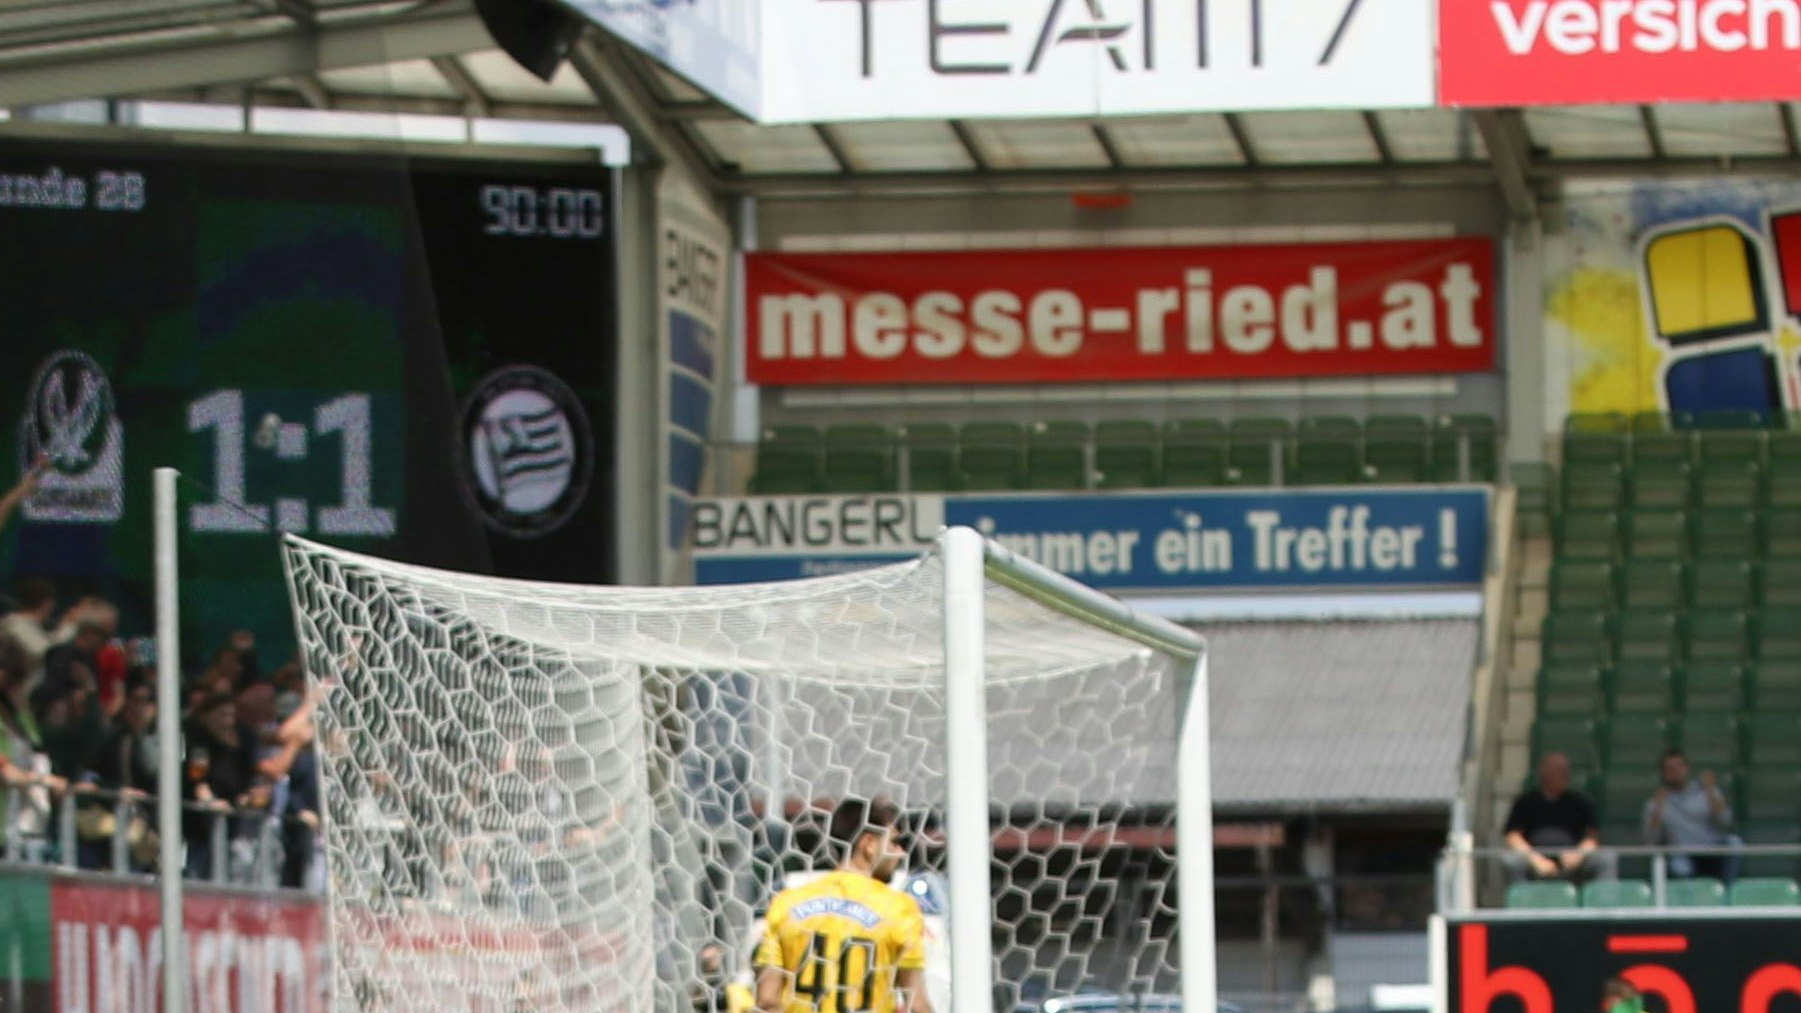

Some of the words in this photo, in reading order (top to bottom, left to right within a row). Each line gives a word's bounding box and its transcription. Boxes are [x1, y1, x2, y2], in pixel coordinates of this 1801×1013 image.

[95, 169, 146, 212] 28
[480, 184, 603, 238] 90:00
[758, 262, 1482, 360] messe-ried.at
[186, 388, 398, 537] 1:1
[691, 497, 936, 547] BANGERL
[1154, 512, 1232, 572] ein
[1246, 505, 1424, 570] Treffer
